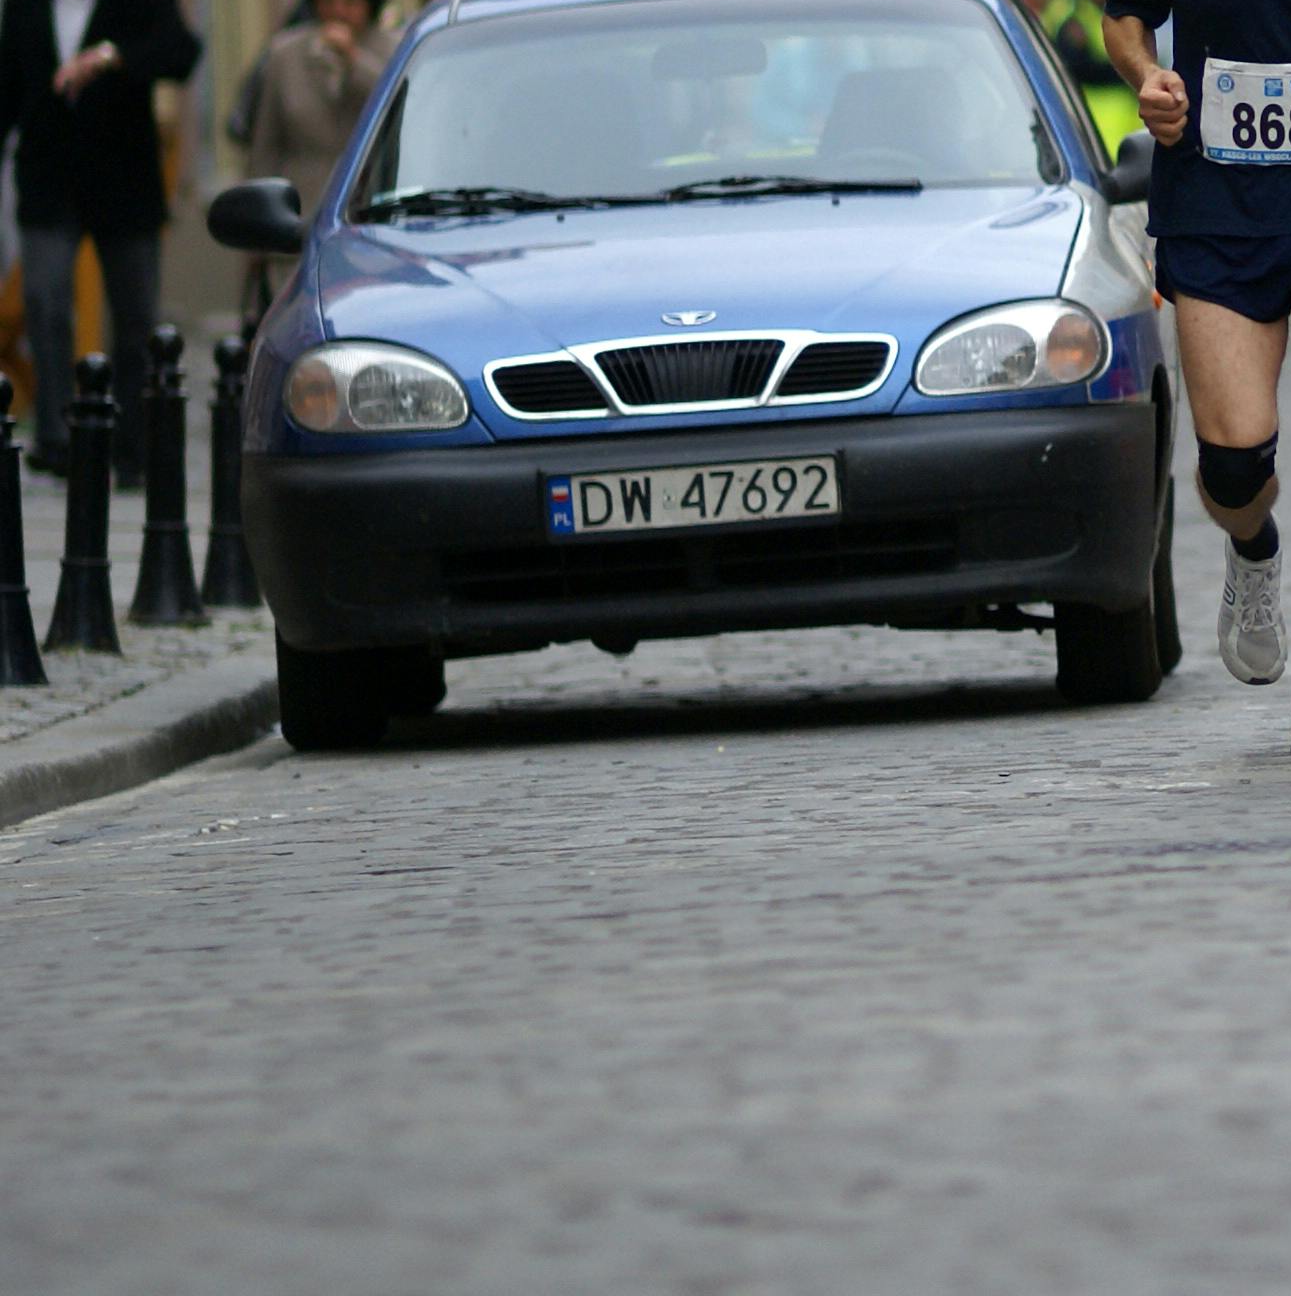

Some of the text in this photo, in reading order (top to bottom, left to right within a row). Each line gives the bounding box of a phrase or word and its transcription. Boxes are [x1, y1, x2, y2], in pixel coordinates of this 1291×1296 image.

[579, 464, 832, 528] DW 47692
[553, 512, 572, 527] PL
